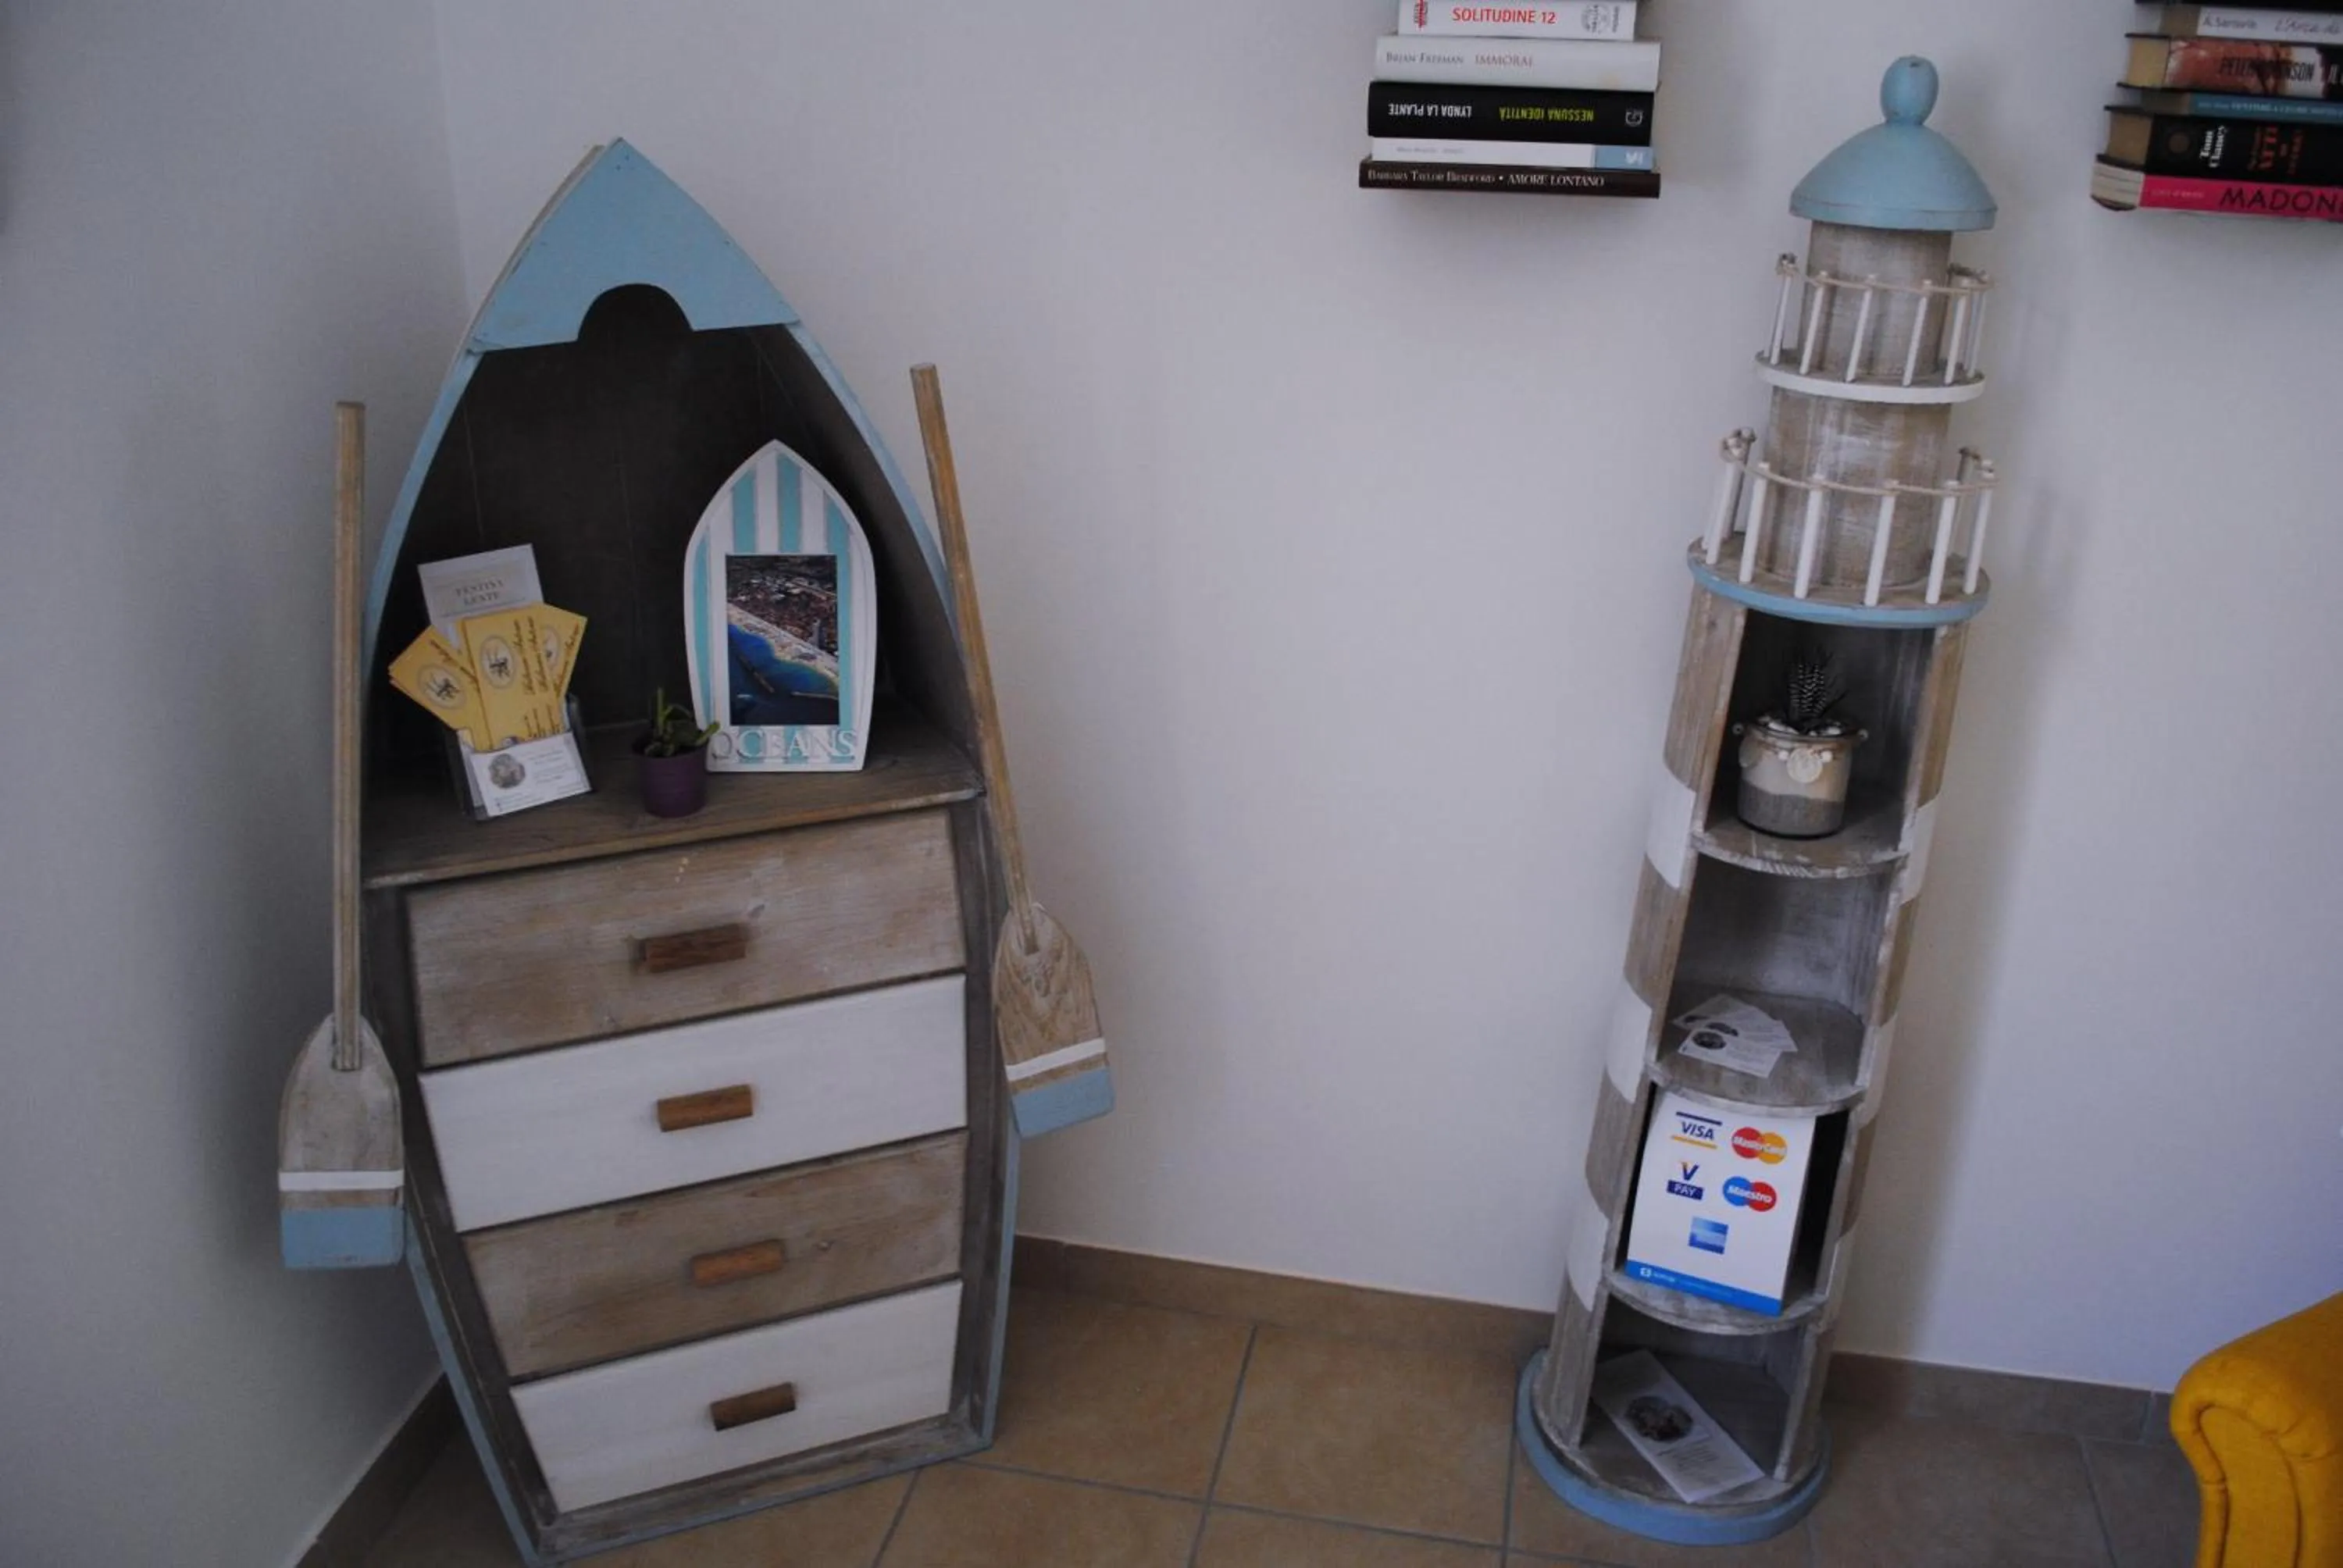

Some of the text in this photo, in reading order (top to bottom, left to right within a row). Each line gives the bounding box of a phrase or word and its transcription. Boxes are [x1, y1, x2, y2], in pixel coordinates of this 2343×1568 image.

[1452, 7, 1557, 24] SOLITUDINE 12
[1388, 102, 1472, 118] LYNDA LA PLANTE
[1547, 108, 1595, 123] NESSUNA
[1507, 174, 1547, 187] AMORE
[1550, 175, 1605, 188] LONTANO
[2219, 187, 2343, 216] MADON
[708, 728, 857, 764] OCEANS
[1681, 1121, 1715, 1141] VISA
[1681, 1161, 1700, 1181] V
[1674, 1183, 1697, 1197] PAY
[1726, 1185, 1773, 1204] Maestro
